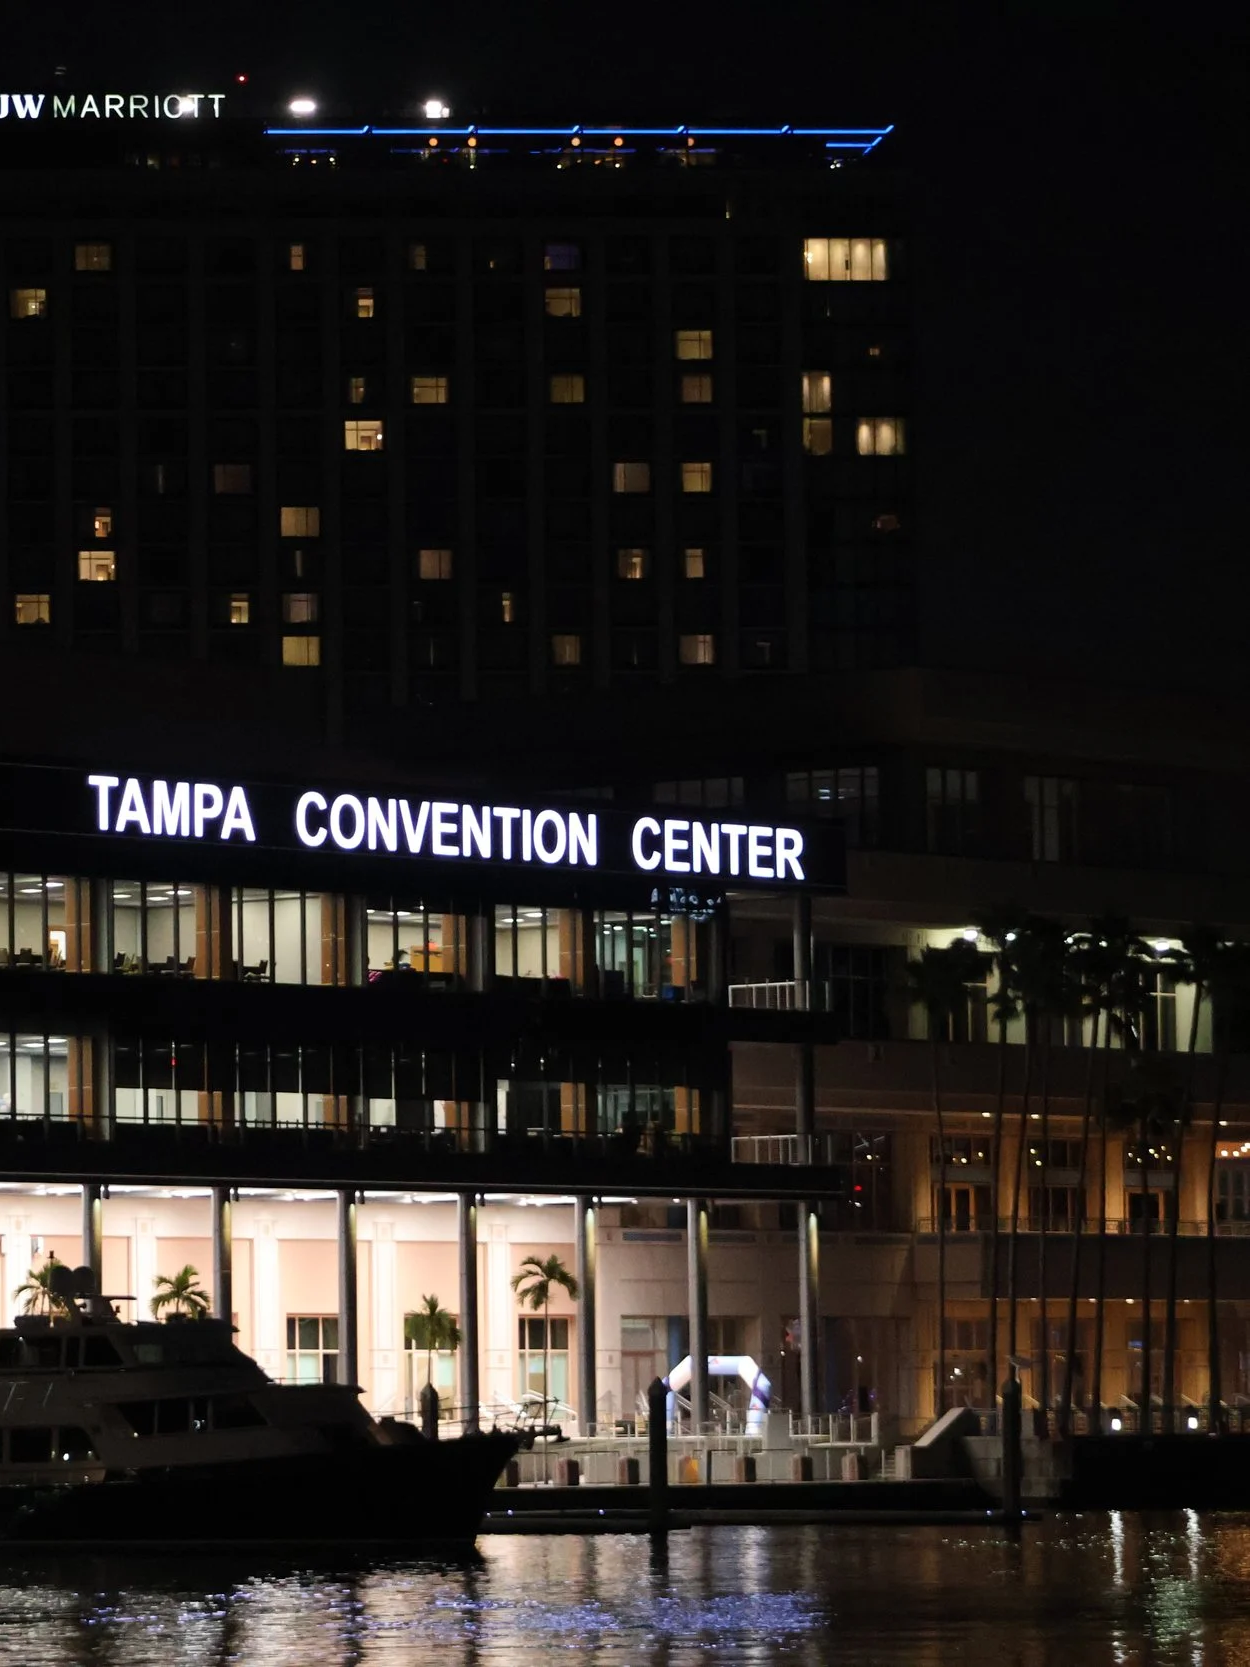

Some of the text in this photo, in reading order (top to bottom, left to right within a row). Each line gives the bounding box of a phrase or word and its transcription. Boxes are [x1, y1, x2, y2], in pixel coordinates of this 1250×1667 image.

[53, 94, 226, 119] MARRIOTT
[88, 775, 806, 880] TAMPA CONVENTION CENTER
